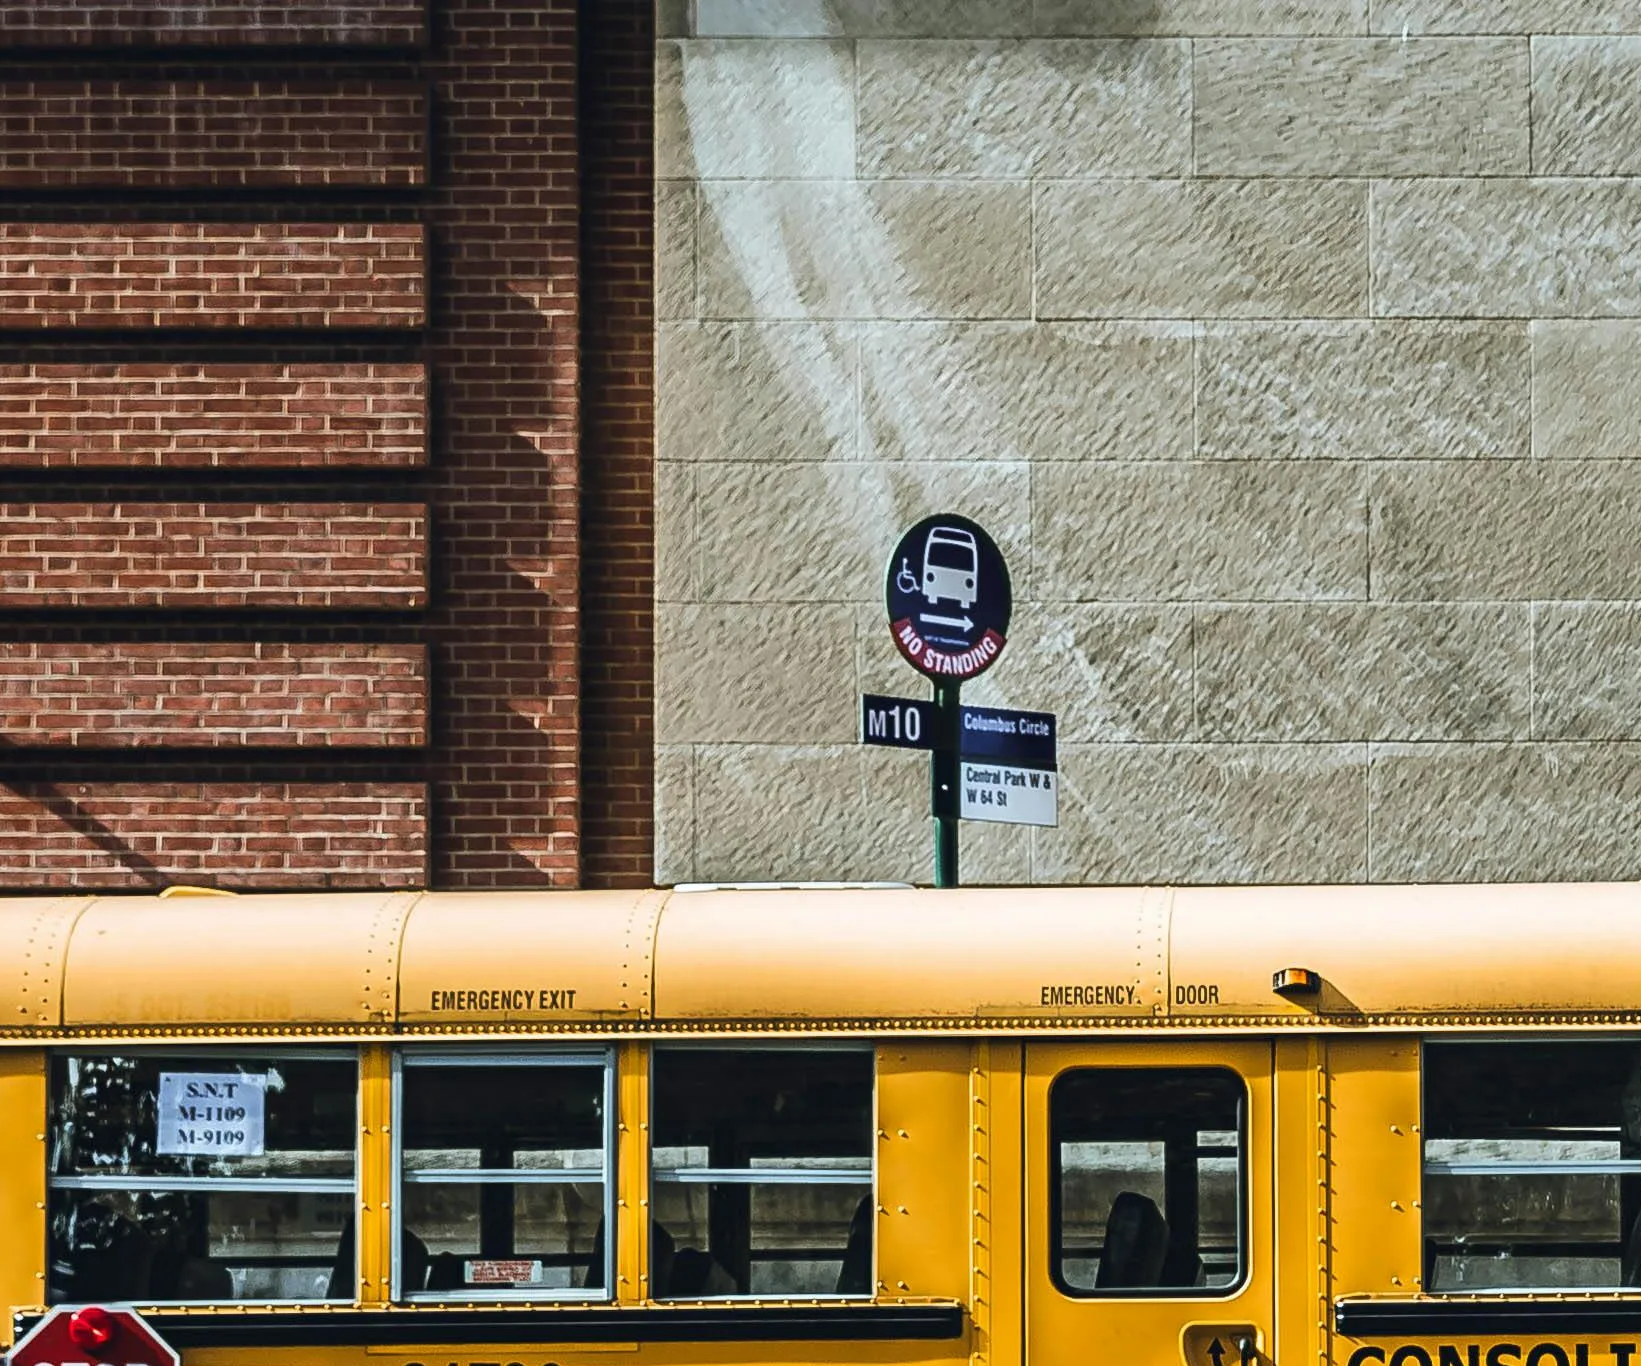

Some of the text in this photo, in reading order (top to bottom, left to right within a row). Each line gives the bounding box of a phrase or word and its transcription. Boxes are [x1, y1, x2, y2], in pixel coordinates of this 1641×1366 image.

[899, 625, 998, 675] NO STANDING
[868, 704, 921, 741] M10
[964, 712, 1050, 736] Columbus Circle
[966, 766, 1051, 790] Central Park W &
[966, 788, 977, 803] W
[997, 790, 1007, 807] St
[431, 989, 577, 1011] EMERGENCY EXIT
[1041, 984, 1220, 1006] EMERGENCY DOOR
[186, 1082, 239, 1099] S.N.T
[178, 1105, 246, 1122] M-1109
[177, 1129, 245, 1145] M-9109
